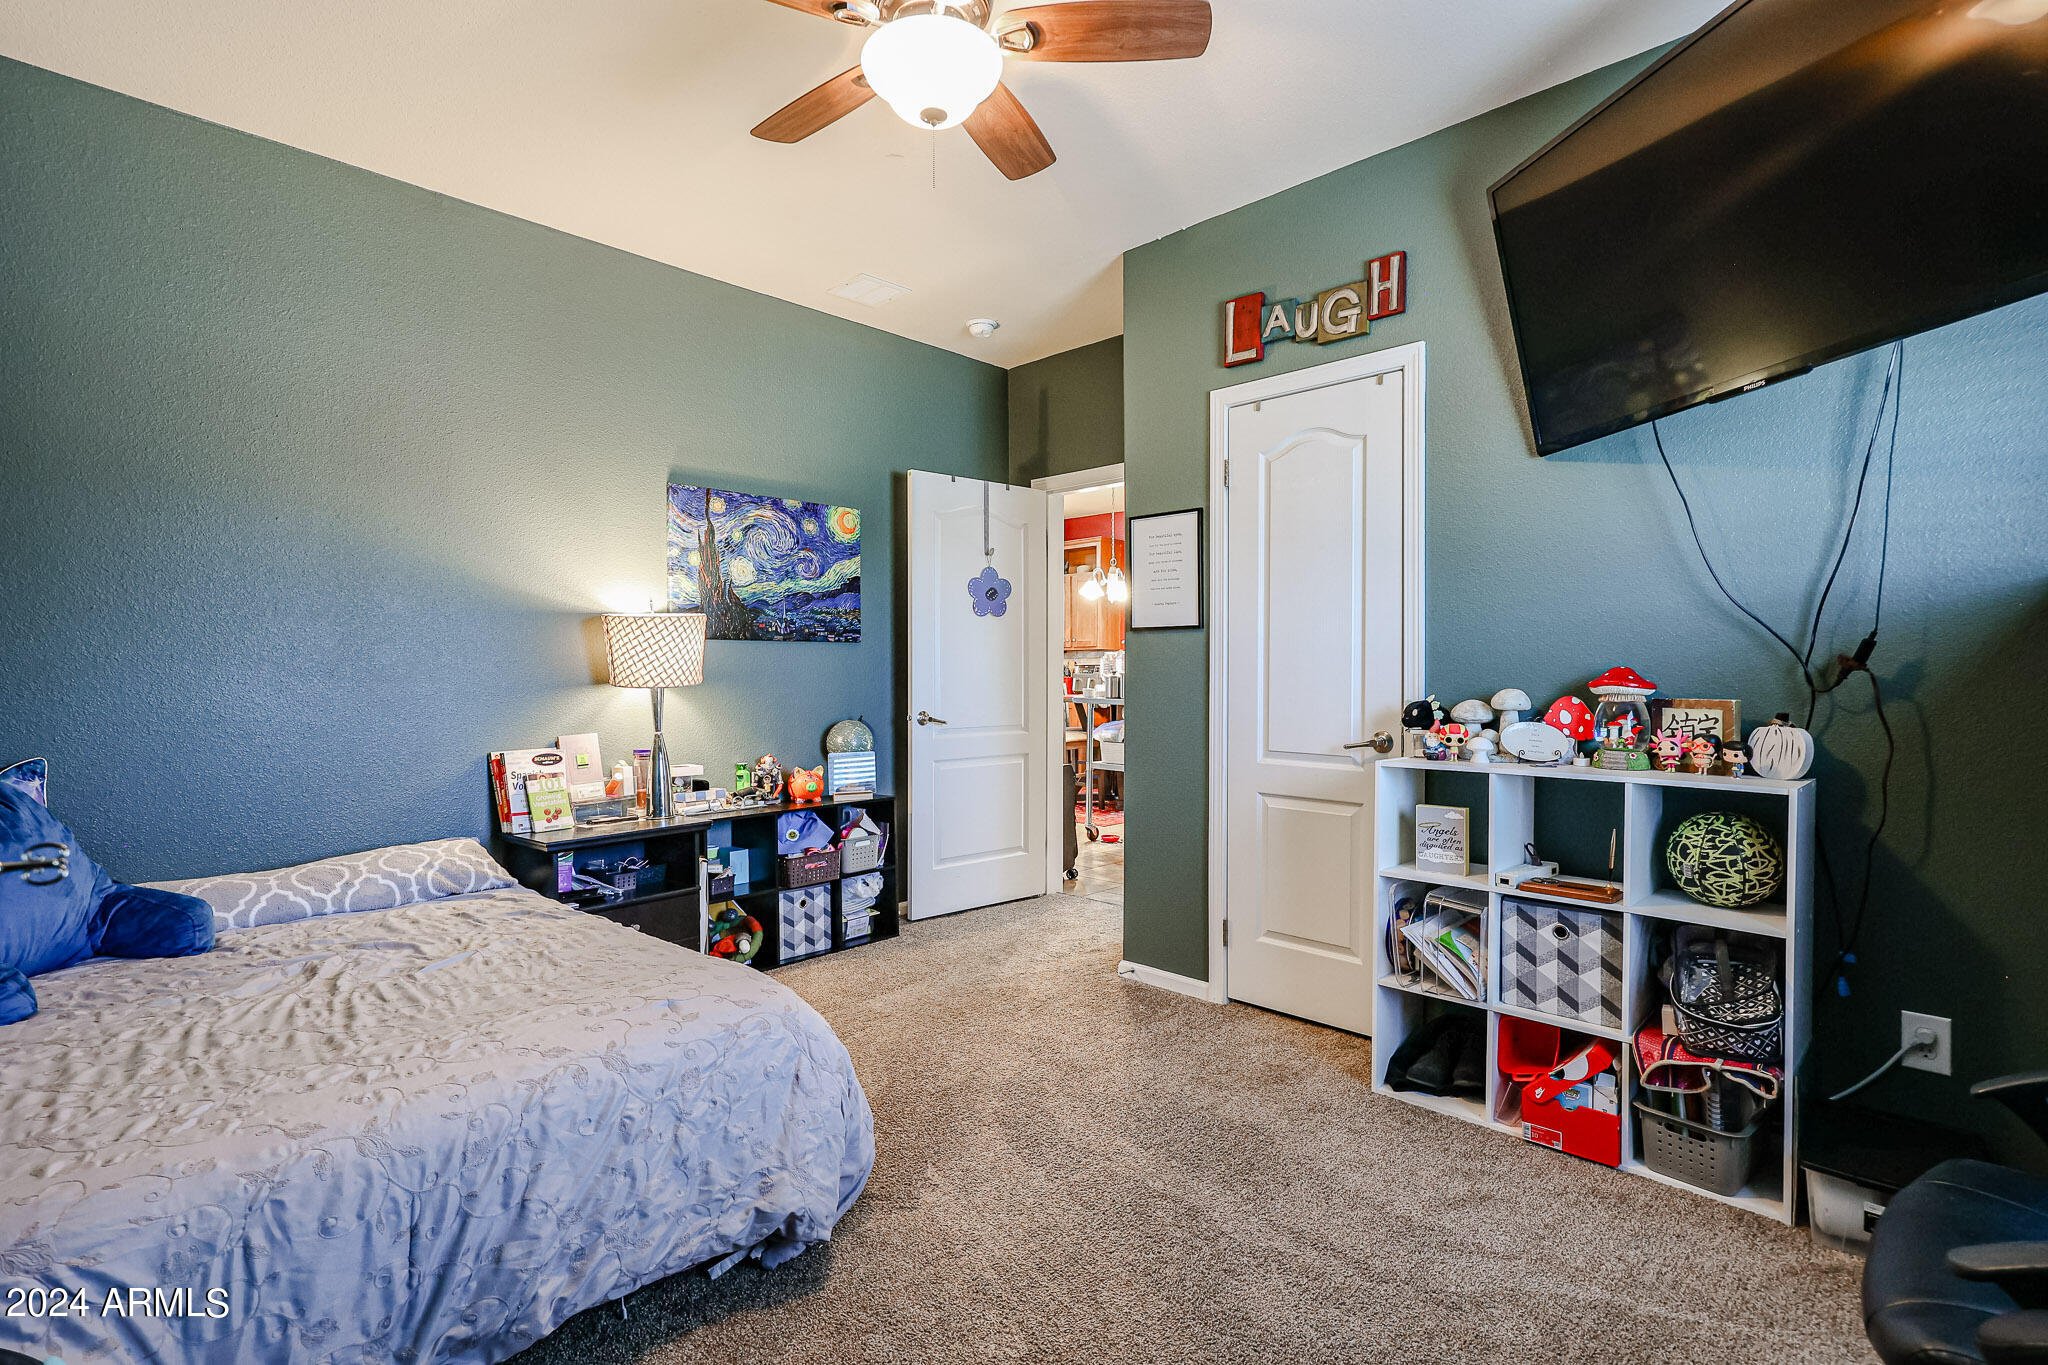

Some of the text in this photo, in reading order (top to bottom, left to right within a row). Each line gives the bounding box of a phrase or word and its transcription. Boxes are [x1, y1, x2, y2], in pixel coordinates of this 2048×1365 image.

[1225, 254, 1401, 364] LAUGH
[1743, 380, 1766, 391] PHILIPS
[537, 778, 564, 791] 101
[1421, 826, 1458, 837] Angels
[1420, 841, 1453, 850] disguised
[1442, 836, 1462, 845] often
